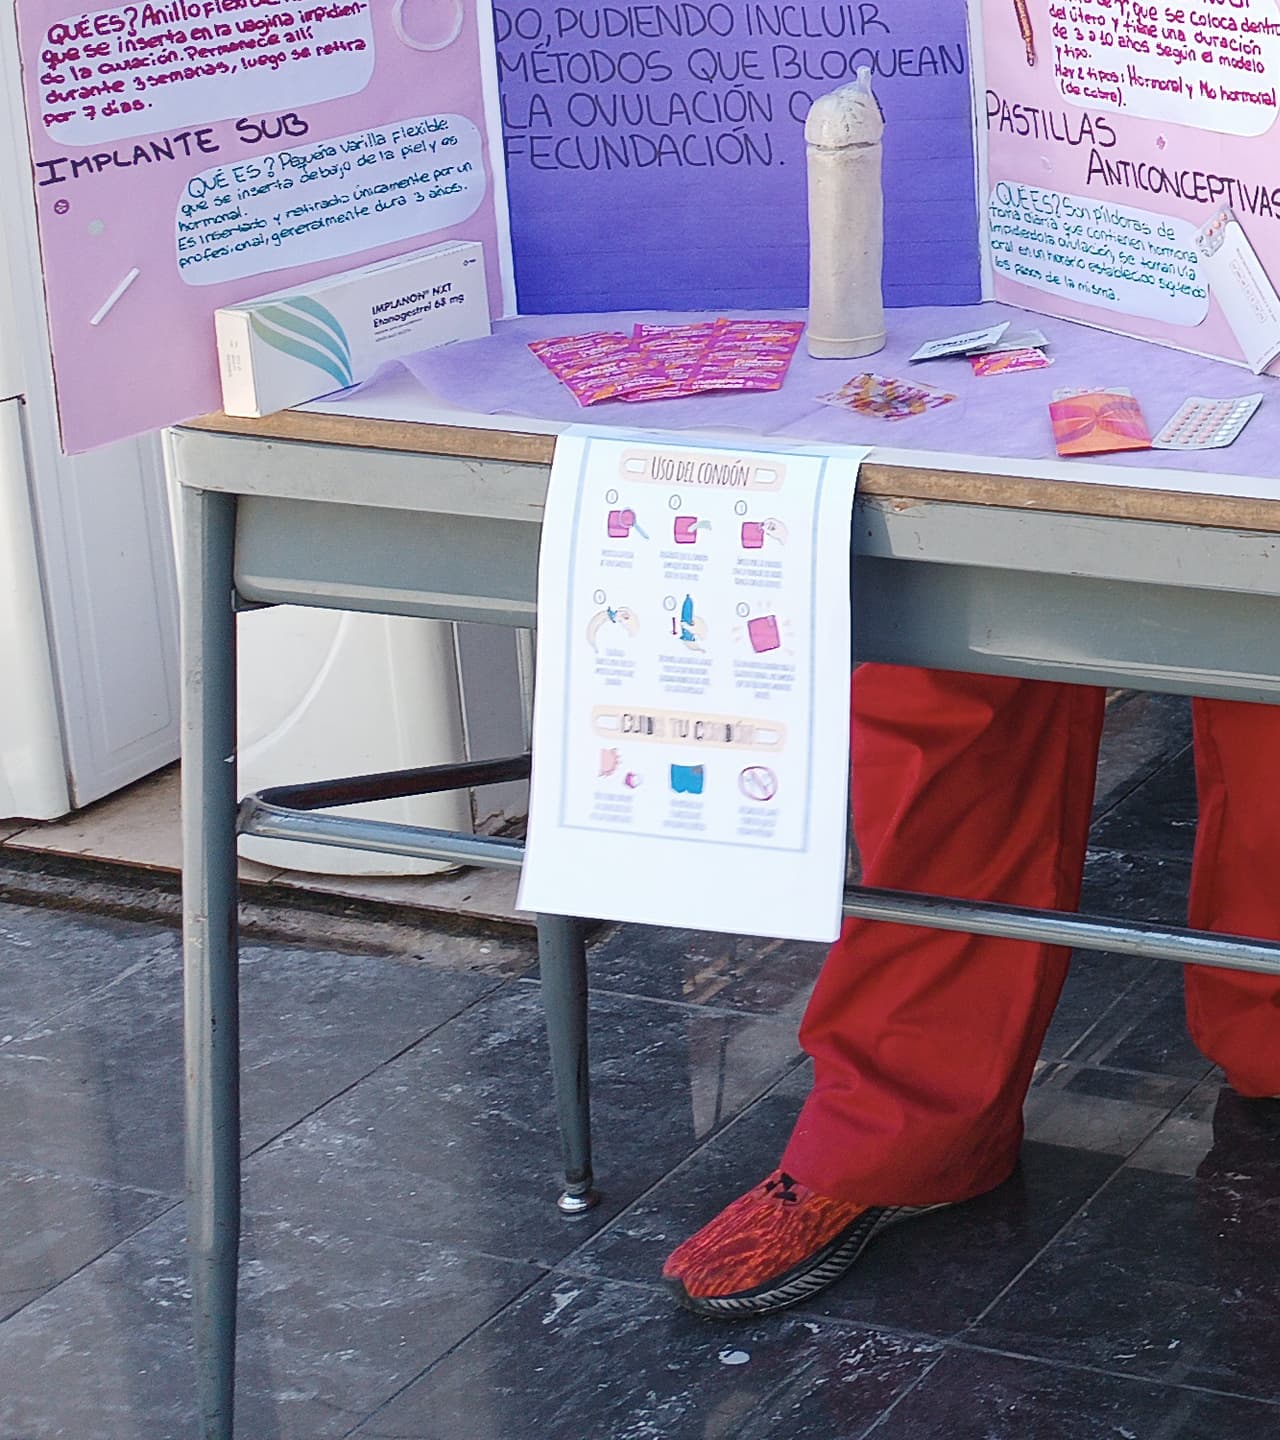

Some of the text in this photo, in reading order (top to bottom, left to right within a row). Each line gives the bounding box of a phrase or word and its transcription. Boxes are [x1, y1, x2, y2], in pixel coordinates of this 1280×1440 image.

[556, 4, 734, 40] PUDIENDO
[746, 3, 890, 38] INCLUIR
[1132, 1, 1158, 22] que
[1165, 7, 1184, 23] se
[83, 42, 110, 58] se
[1052, 22, 1264, 74] de 3 modelo
[1162, 27, 1261, 55] una duración
[69, 65, 92, 80] la
[499, 41, 965, 84] MÉTODOS QUE BLOQUEAN
[133, 76, 146, 91] 3
[1185, 83, 1192, 99] y
[503, 85, 773, 130] LA OVULACIÓN
[985, 90, 1117, 147] PASTILLAS
[36, 113, 309, 186] IMPLANTE SUB
[504, 127, 786, 171] FECUNDACIÓN.
[214, 194, 232, 206] se
[357, 152, 377, 167] de
[401, 139, 426, 159] piel
[413, 191, 425, 203] 3
[1157, 221, 1175, 241] de
[652, 456, 750, 486] USO DEL CONDÓN
